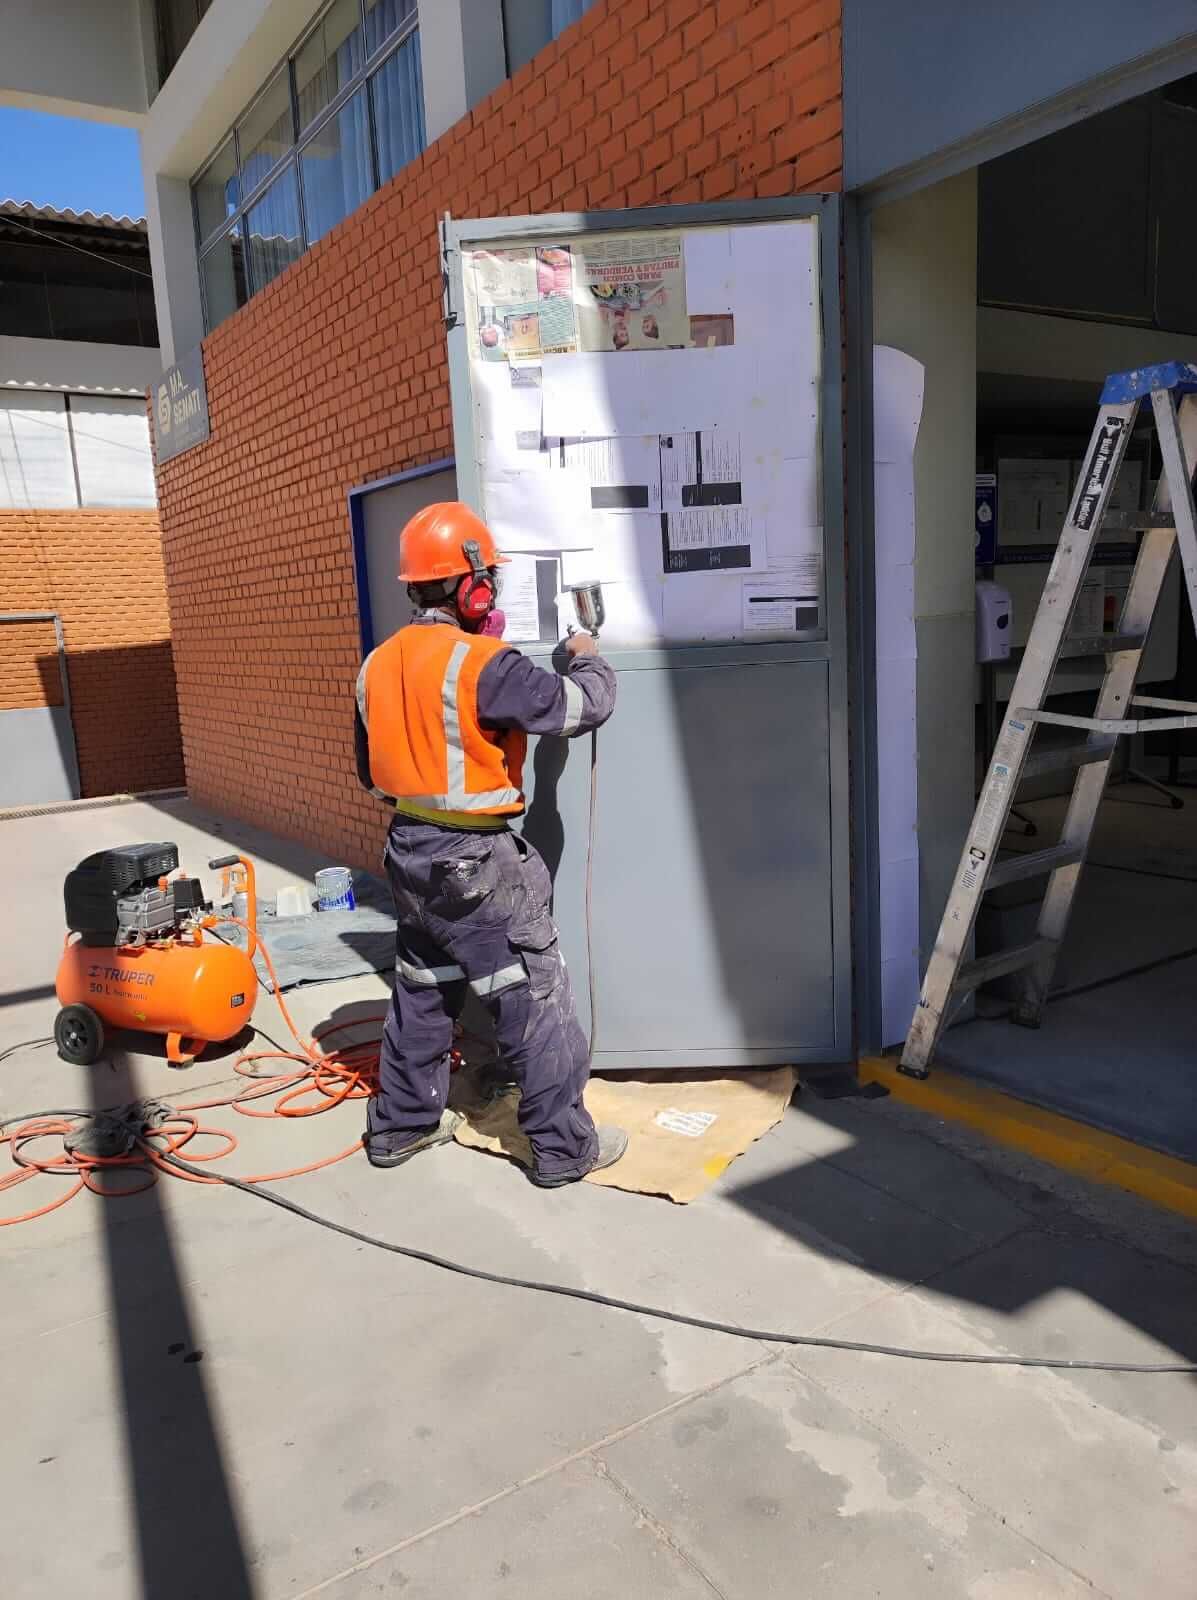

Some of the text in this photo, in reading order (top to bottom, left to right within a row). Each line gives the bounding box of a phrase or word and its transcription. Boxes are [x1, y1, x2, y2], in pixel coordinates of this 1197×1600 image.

[103, 967, 154, 986] TRUPER
[90, 983, 103, 993] 50
[105, 984, 111, 996] L
